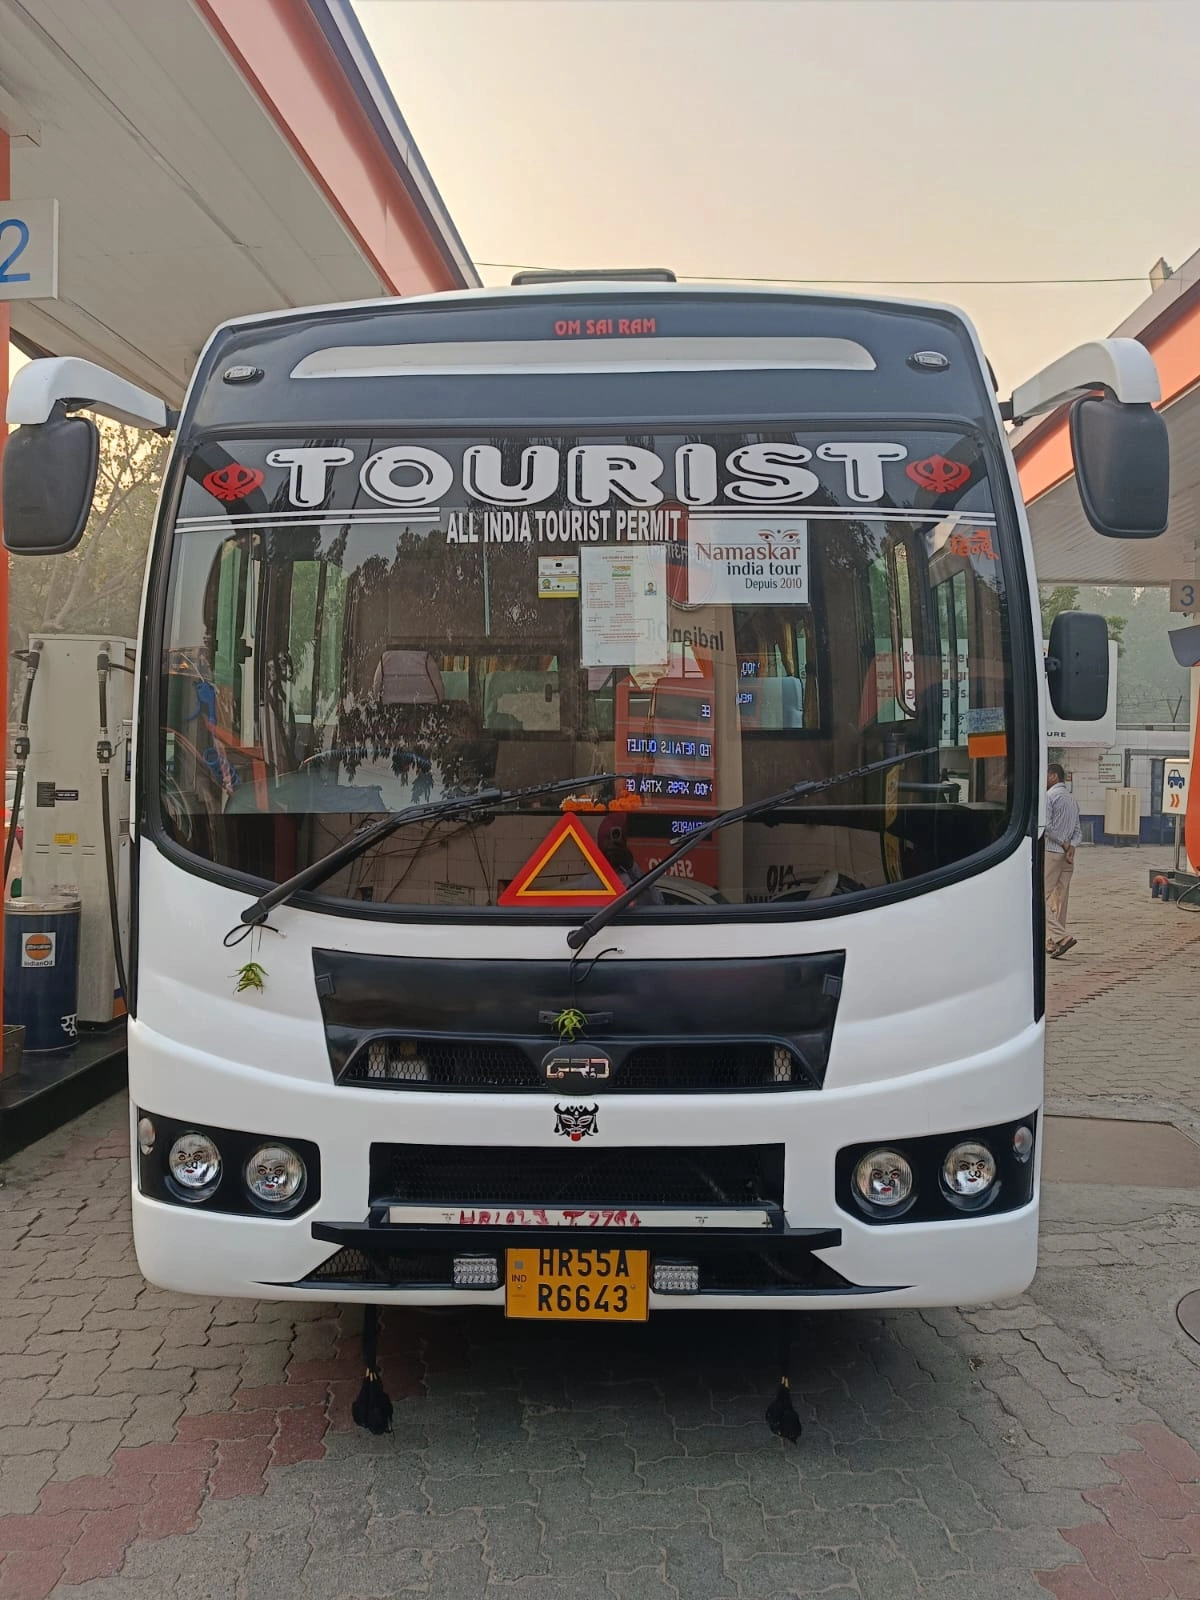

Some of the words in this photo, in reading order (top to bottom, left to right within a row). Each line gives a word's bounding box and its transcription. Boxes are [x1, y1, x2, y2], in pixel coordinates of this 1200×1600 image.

[0, 219, 30, 283] 2
[554, 319, 581, 336] OM
[586, 319, 613, 335] SAI
[618, 318, 656, 334] RAM
[265, 442, 908, 508] TOURIST
[446, 511, 479, 544] ALL
[484, 511, 532, 543] INDIA
[535, 510, 611, 542] TOURIST
[616, 509, 682, 541] PERMIT
[696, 542, 801, 561] Namaskar
[727, 561, 764, 576] india
[769, 561, 802, 576] tour
[745, 577, 778, 592] Depuis
[780, 577, 802, 589] 2010
[1180, 585, 1194, 606] 3
[539, 1249, 630, 1277] HR55A
[511, 1275, 527, 1283] IND
[538, 1284, 628, 1313] R6643
